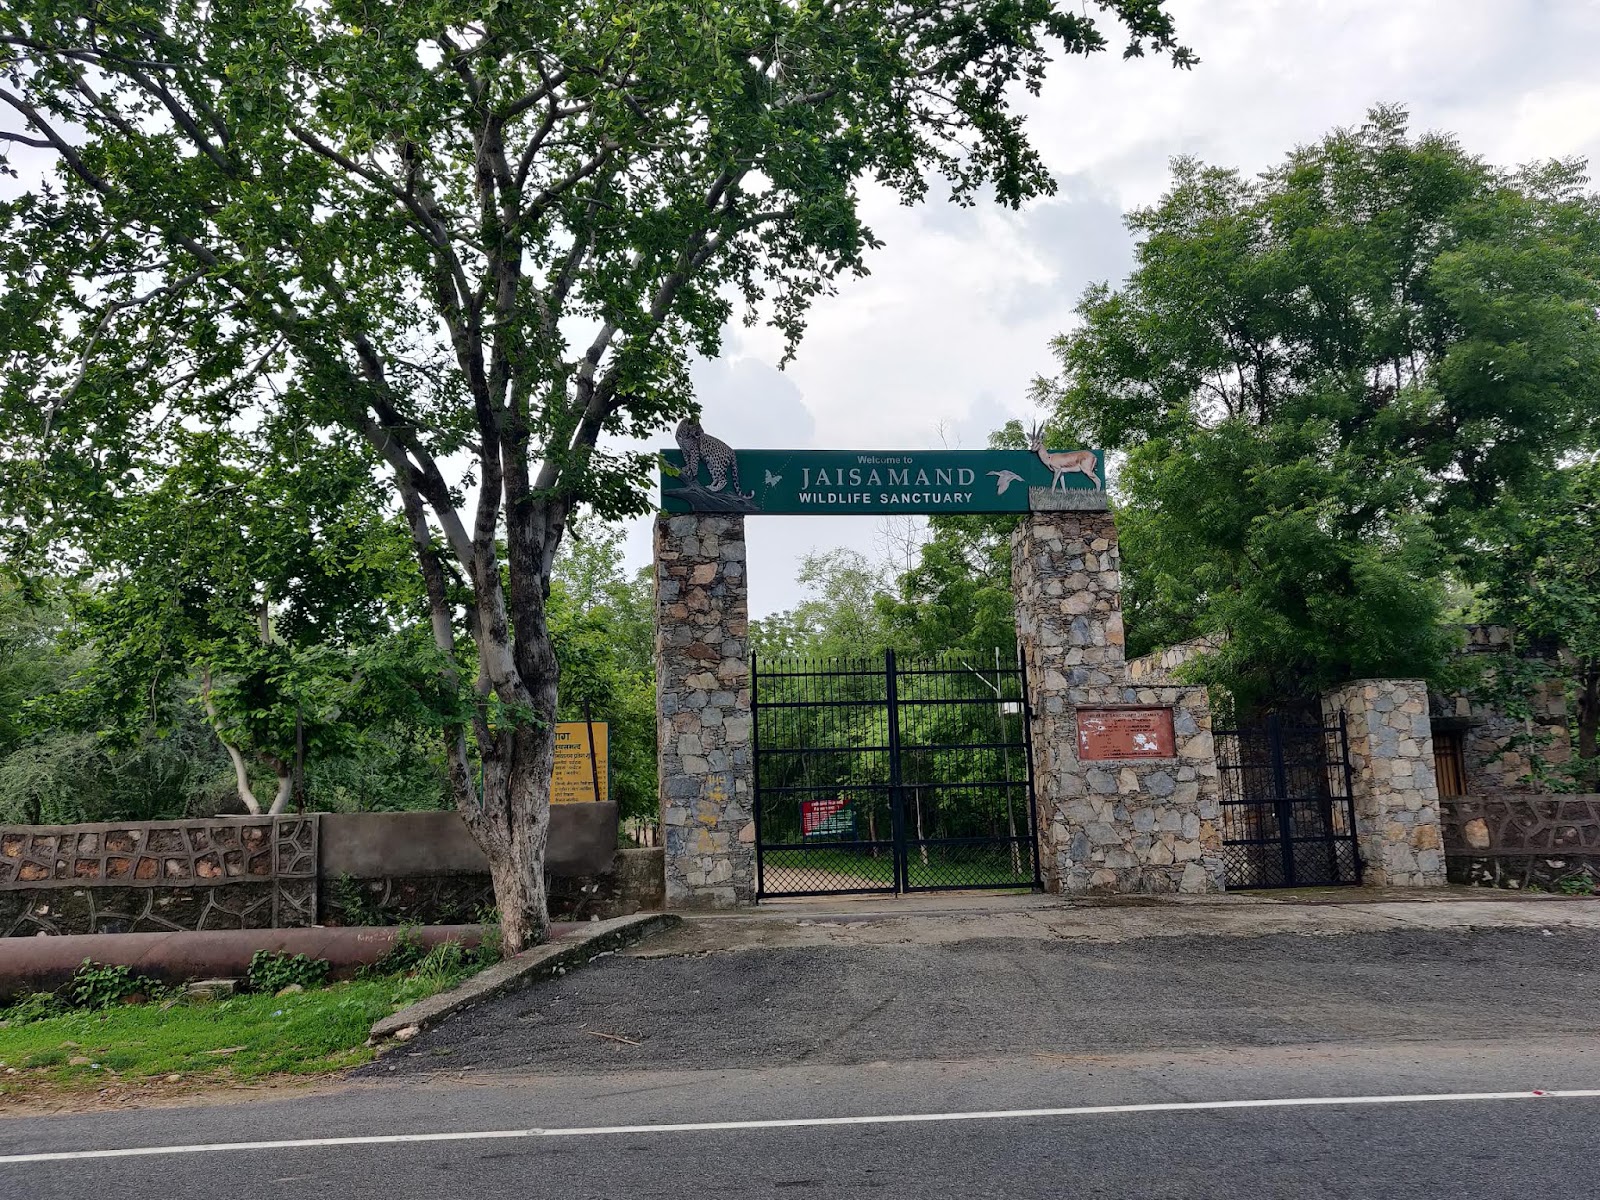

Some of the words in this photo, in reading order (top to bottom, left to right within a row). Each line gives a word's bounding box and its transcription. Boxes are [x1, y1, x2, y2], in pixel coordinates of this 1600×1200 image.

[857, 455, 900, 464] Welcome
[903, 455, 913, 464] to
[801, 467, 976, 490] JAISAMAND
[799, 492, 871, 504] WILDLIFE
[880, 492, 973, 504] SANCTUARY
